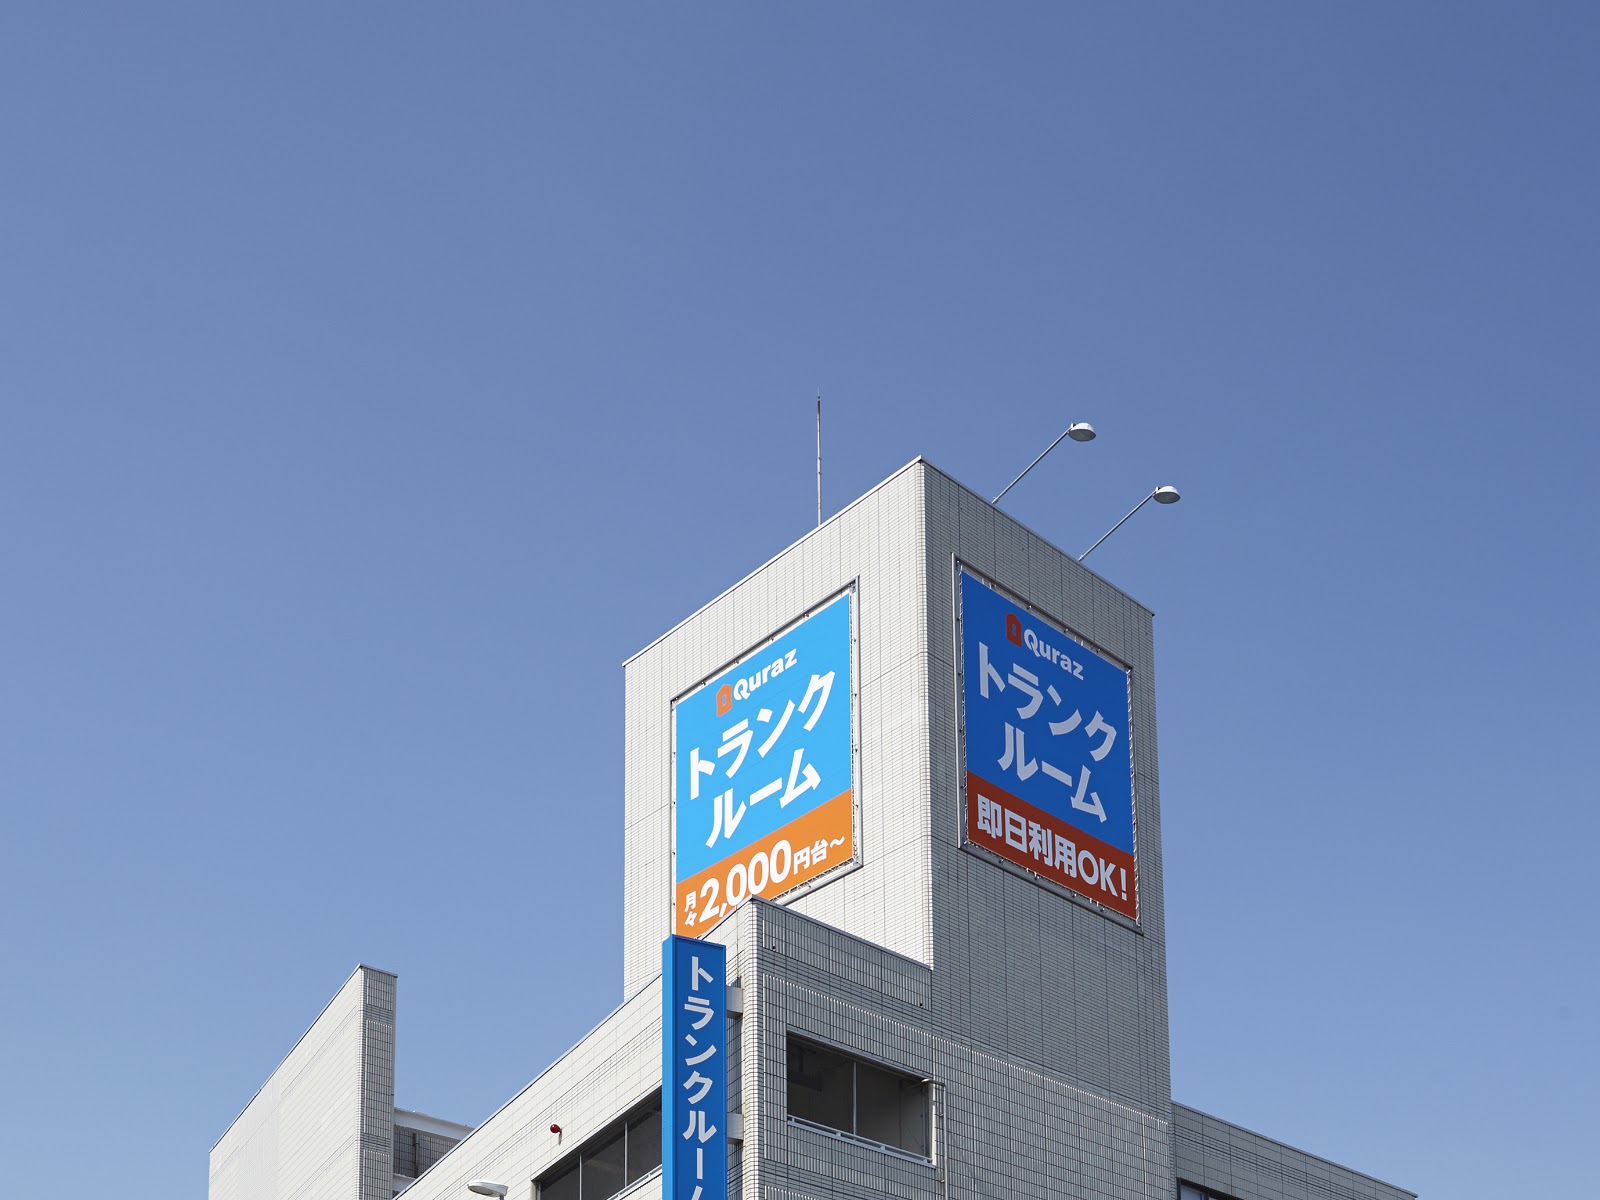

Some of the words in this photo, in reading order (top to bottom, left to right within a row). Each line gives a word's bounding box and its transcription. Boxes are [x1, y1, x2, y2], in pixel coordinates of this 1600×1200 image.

[733, 648, 797, 701] Quraz
[979, 641, 1118, 762] トランク
[1024, 629, 1084, 680] Quraz
[690, 671, 836, 801] トランク
[997, 722, 1108, 823] ルーム
[705, 748, 821, 848] ルーム
[977, 794, 1128, 901] 即日利用OK!
